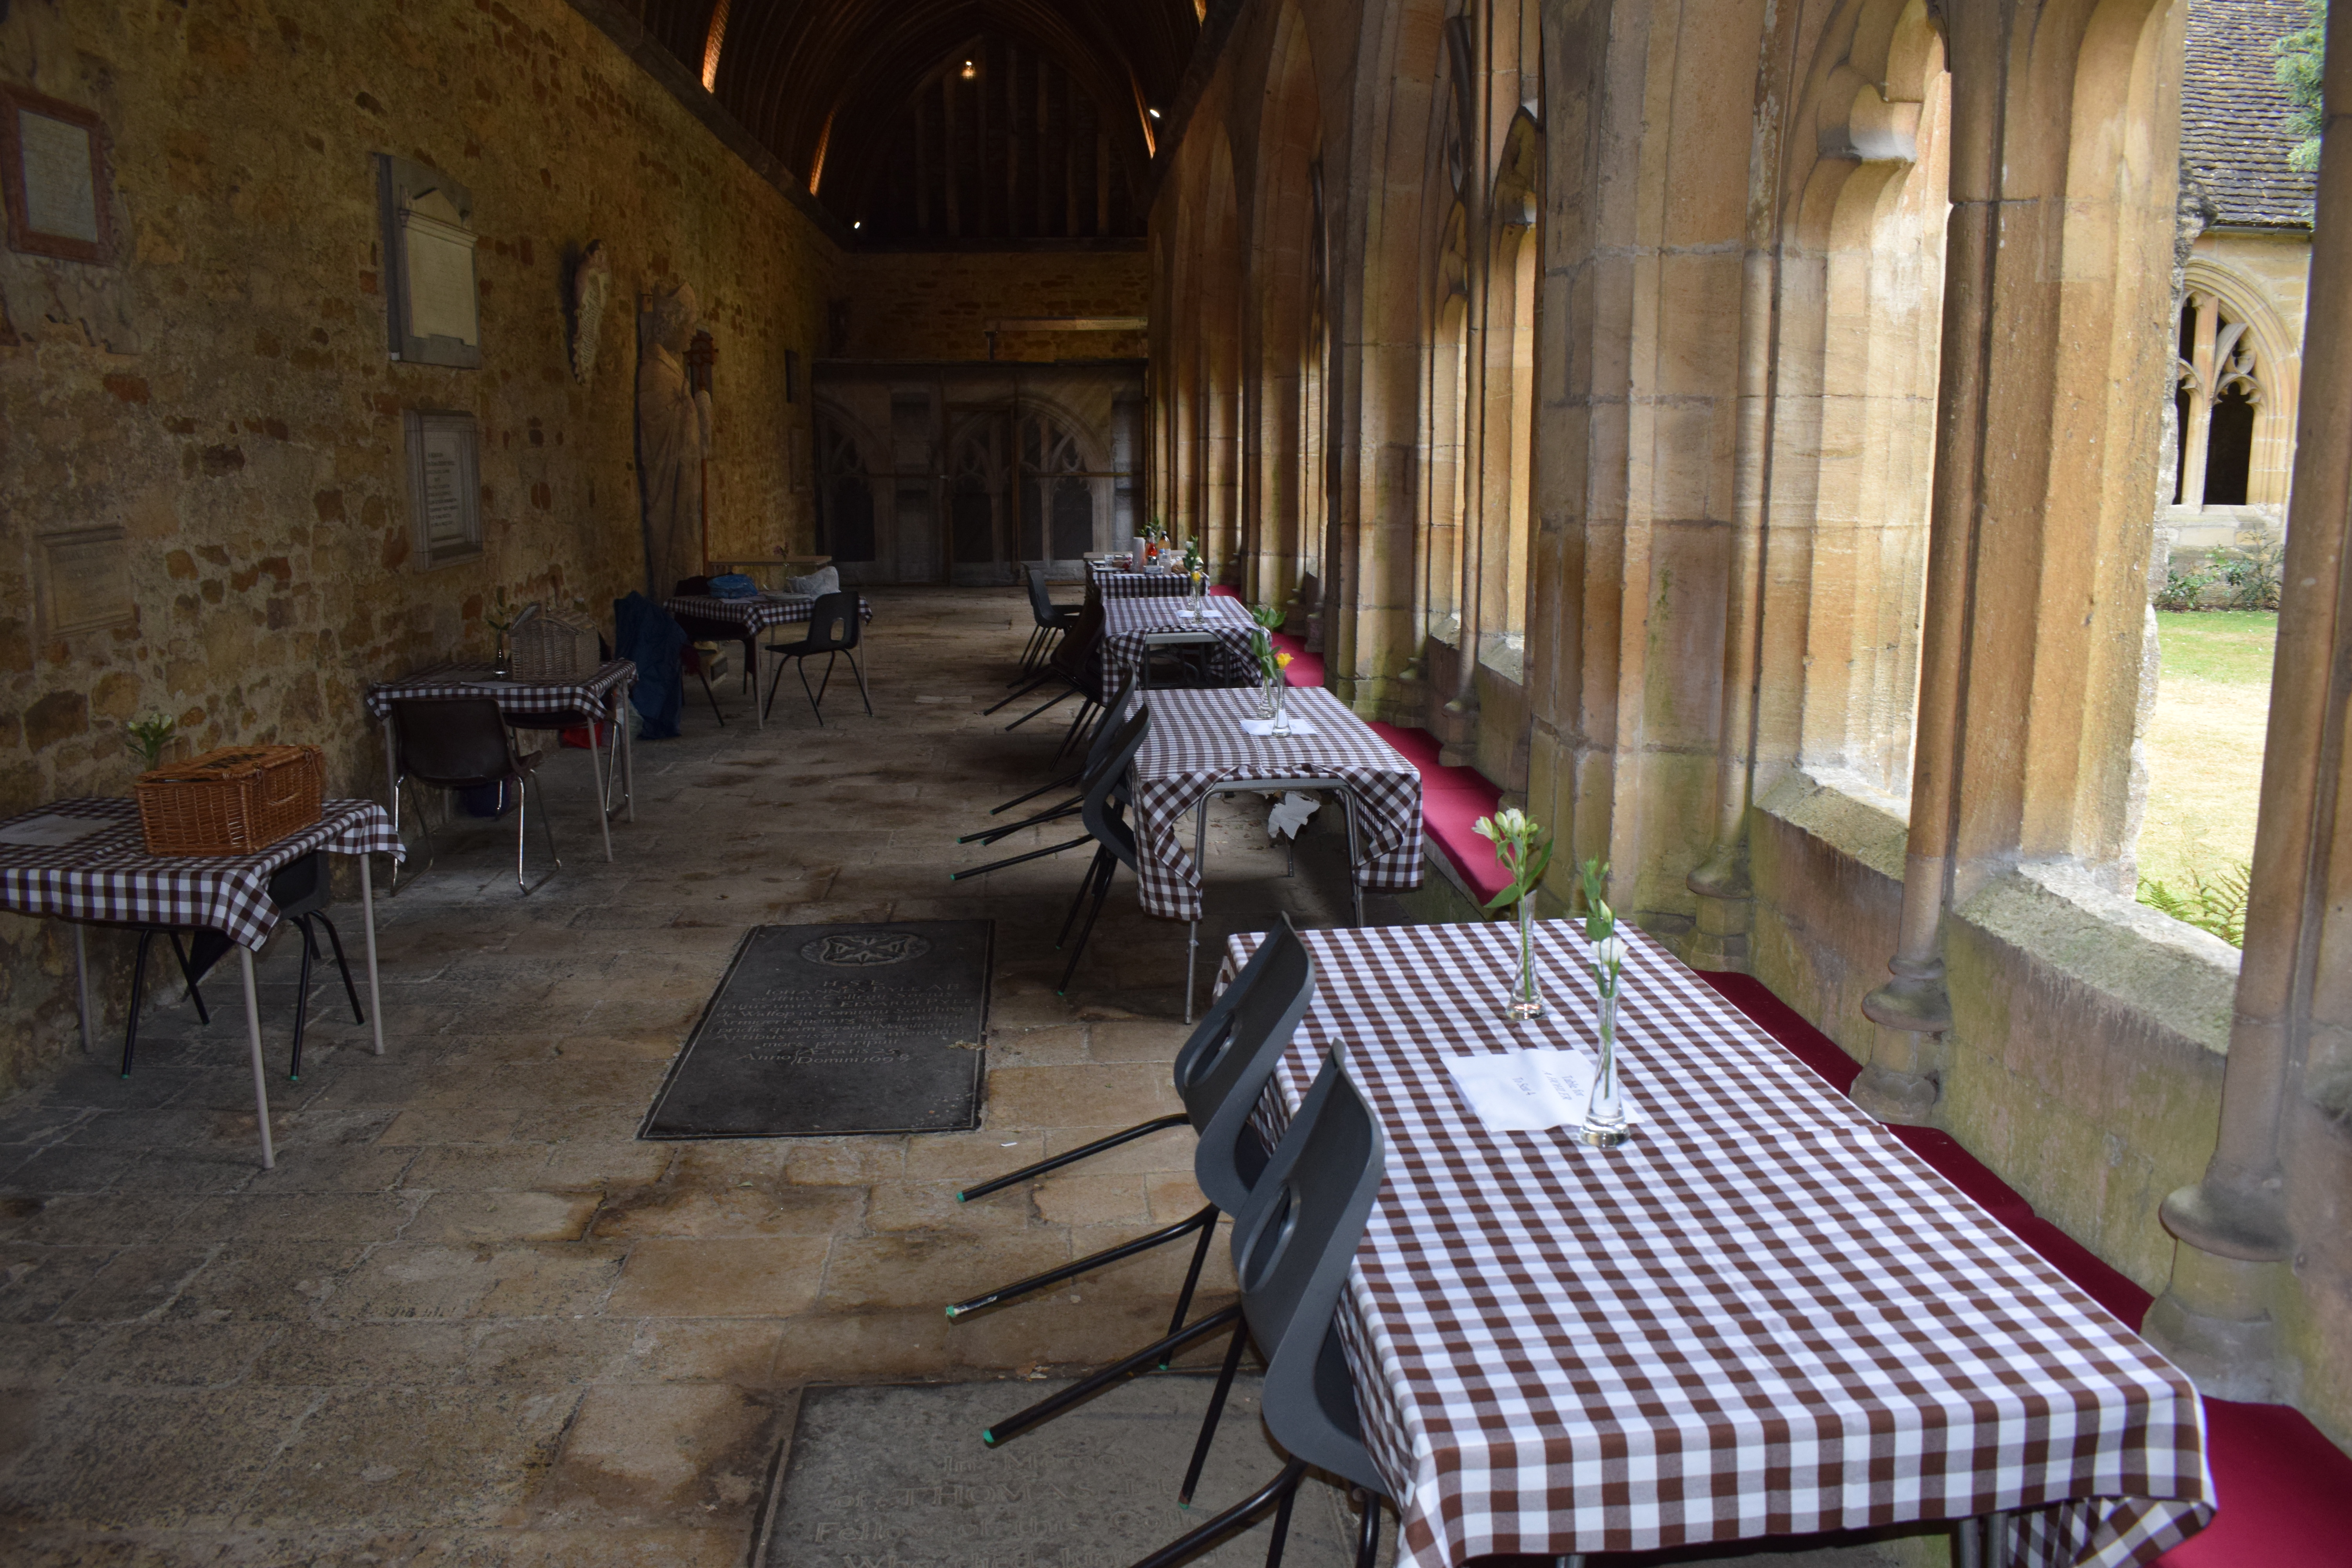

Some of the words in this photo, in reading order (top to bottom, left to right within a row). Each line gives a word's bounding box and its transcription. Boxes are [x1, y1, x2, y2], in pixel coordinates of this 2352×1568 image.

[740, 1011, 794, 1019] Wallop
[797, 1055, 858, 1064] Domini
[815, 1522, 935, 1542] Fellow
